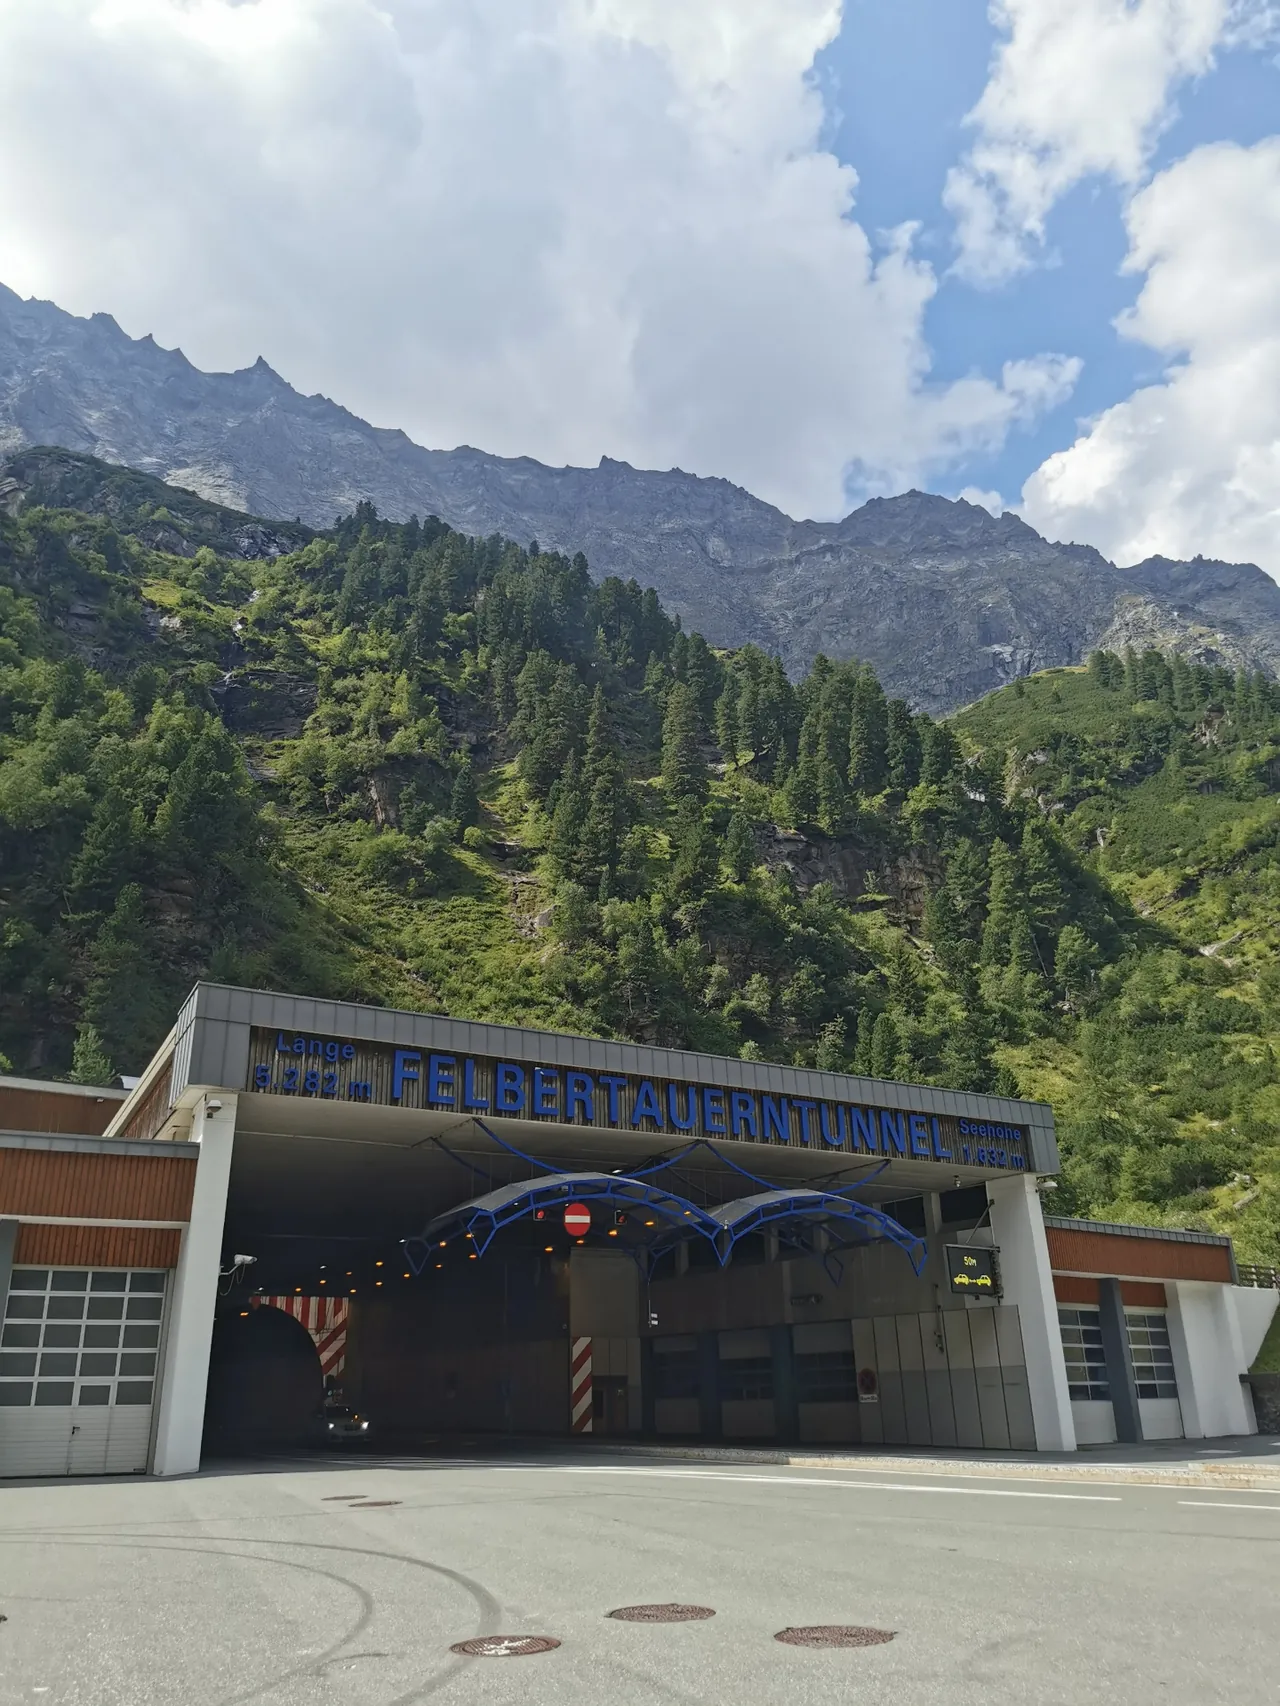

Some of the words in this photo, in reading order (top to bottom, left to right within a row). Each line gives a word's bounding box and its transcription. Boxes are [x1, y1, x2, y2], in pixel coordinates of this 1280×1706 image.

[255, 1063, 338, 1094] 5.282
[349, 1081, 371, 1098] m
[393, 1049, 951, 1158] FELBERTAUERNTUNNEL
[1010, 1153, 1025, 1168] m
